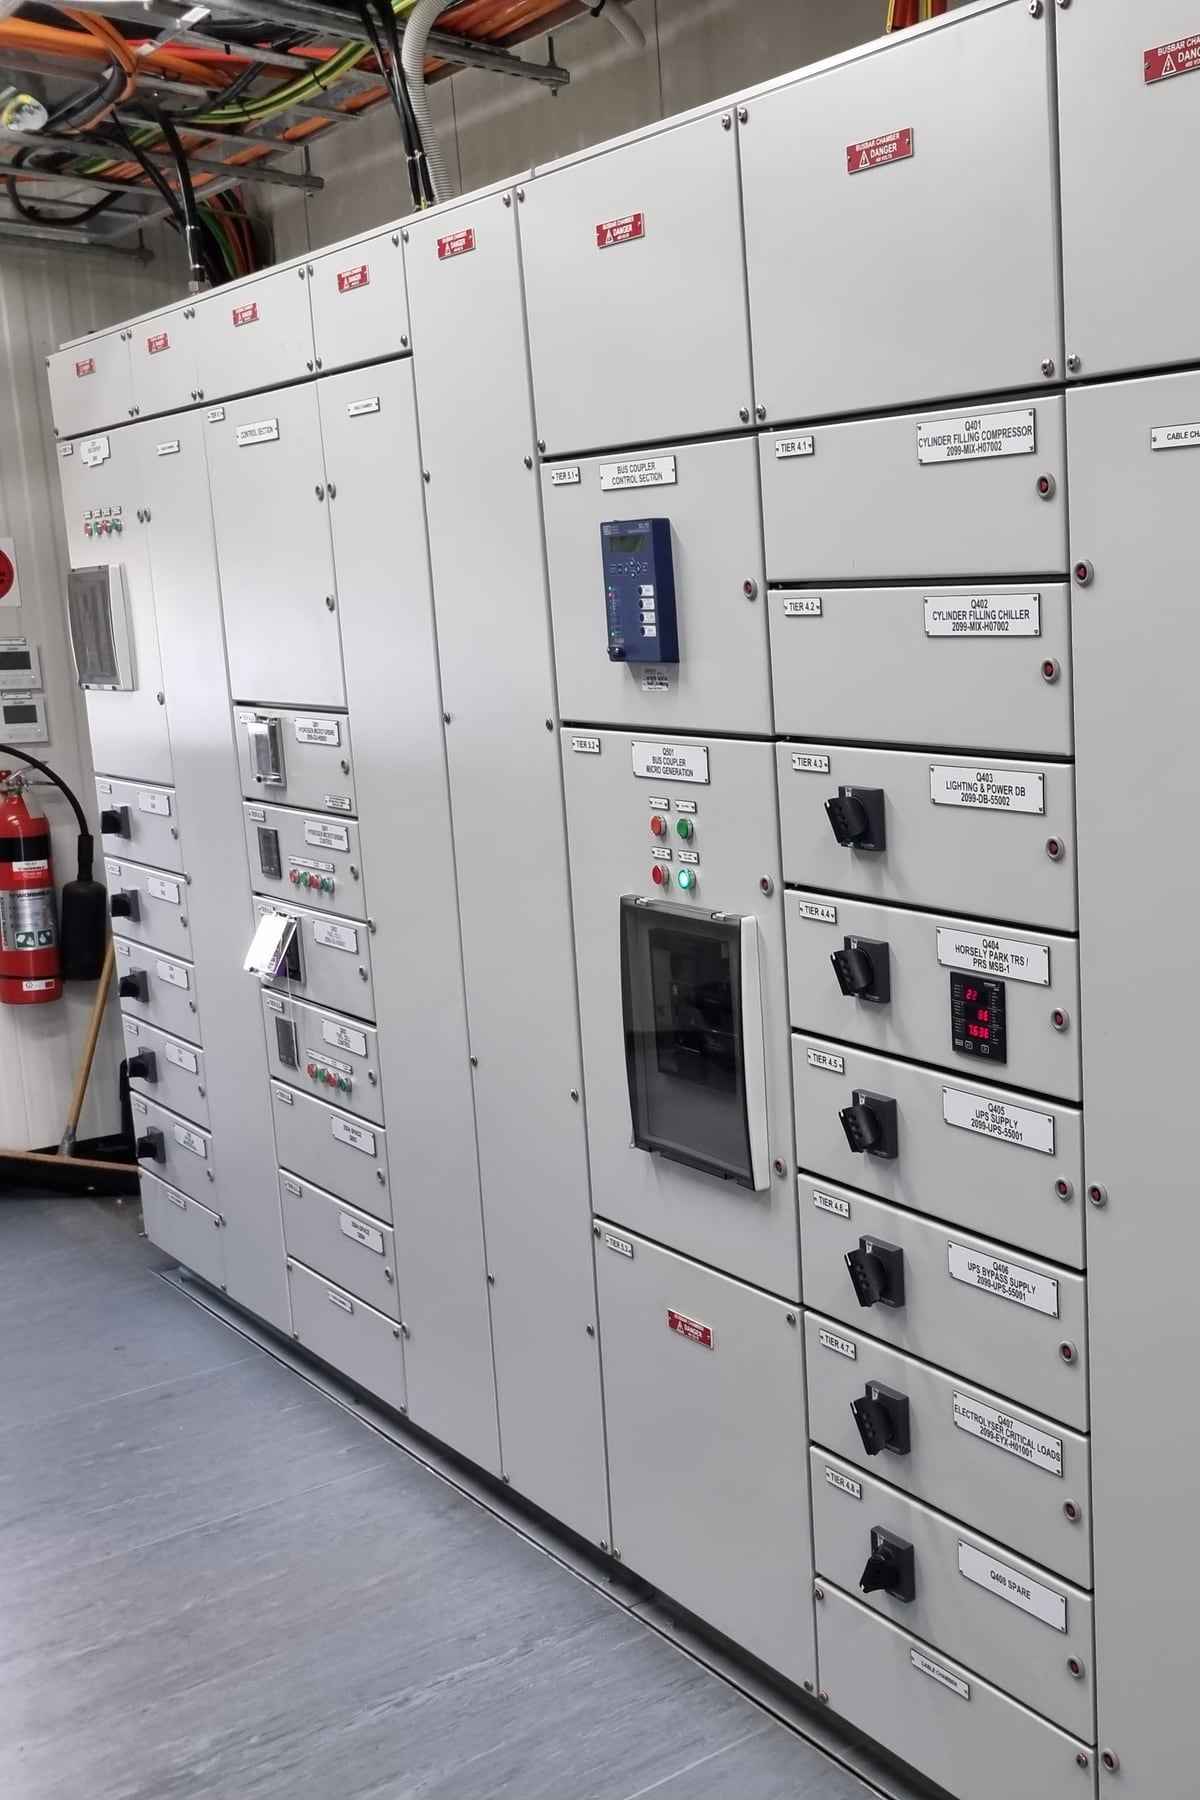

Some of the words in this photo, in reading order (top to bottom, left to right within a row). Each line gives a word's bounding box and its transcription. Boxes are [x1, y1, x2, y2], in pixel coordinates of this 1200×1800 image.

[870, 142, 897, 159] DANGER
[965, 420, 981, 432] Q401
[917, 434, 952, 449] CYLINDER
[953, 431, 980, 444] FILLING
[981, 425, 1033, 441] COMPRESSOR
[1166, 431, 1189, 441] CABLE
[781, 442, 796, 452] TIER
[797, 441, 809, 450] 4.1
[946, 441, 1002, 456] 2099-MIX-H07002
[617, 465, 628, 474] BUS
[629, 462, 656, 473] COUPLER
[555, 472, 569, 480] TIER
[611, 475, 638, 485] CONTROL
[639, 472, 663, 483] SECTION
[789, 602, 804, 611] TIER
[805, 601, 817, 611] 4.2
[971, 599, 988, 609] Q402
[932, 610, 967, 621] CYLINDER
[969, 610, 997, 620] FILLING
[998, 609, 1030, 620] CHILLER
[952, 621, 1009, 632] 2099-MIX-H07002
[576, 740, 587, 748] TIER
[652, 756, 662, 765] BUS
[661, 757, 686, 767] COUPLER
[797, 757, 812, 767] TIER
[646, 765, 661, 774] MICRO
[660, 766, 693, 777] GENERATION
[976, 772, 993, 783] Q403
[946, 781, 978, 793] LIGHTING
[980, 783, 985, 793] &
[986, 784, 1013, 796] POWER
[1015, 786, 1026, 797] DB
[804, 905, 819, 916] TIER
[821, 909, 832, 918] 4.4
[982, 939, 999, 950] Q404
[955, 944, 987, 959] HORSELY
[989, 950, 1009, 963] PARK
[1010, 954, 1025, 966] TRS
[973, 958, 987, 969] PRS
[989, 960, 1009, 973] MSB-1
[813, 1053, 827, 1064] TIER
[828, 1058, 840, 1068] 4.5
[988, 1103, 1005, 1116] Q405
[975, 1109, 989, 1121] UPS
[991, 1114, 1018, 1129] SUPPLY
[819, 1197, 833, 1208] TIER
[992, 1262, 1009, 1275] Q406
[968, 1261, 981, 1273] UPS
[982, 1267, 1008, 1285] BYPASS
[1009, 1277, 1036, 1294] SUPPLY
[825, 1334, 839, 1348] TIER
[954, 1404, 1003, 1433] ELECTROLYSER
[1004, 1424, 1034, 1448] CRITICAL
[1036, 1441, 1061, 1462] LOADS
[830, 1472, 846, 1487] TIER
[1008, 1580, 1031, 1600] SPARE
